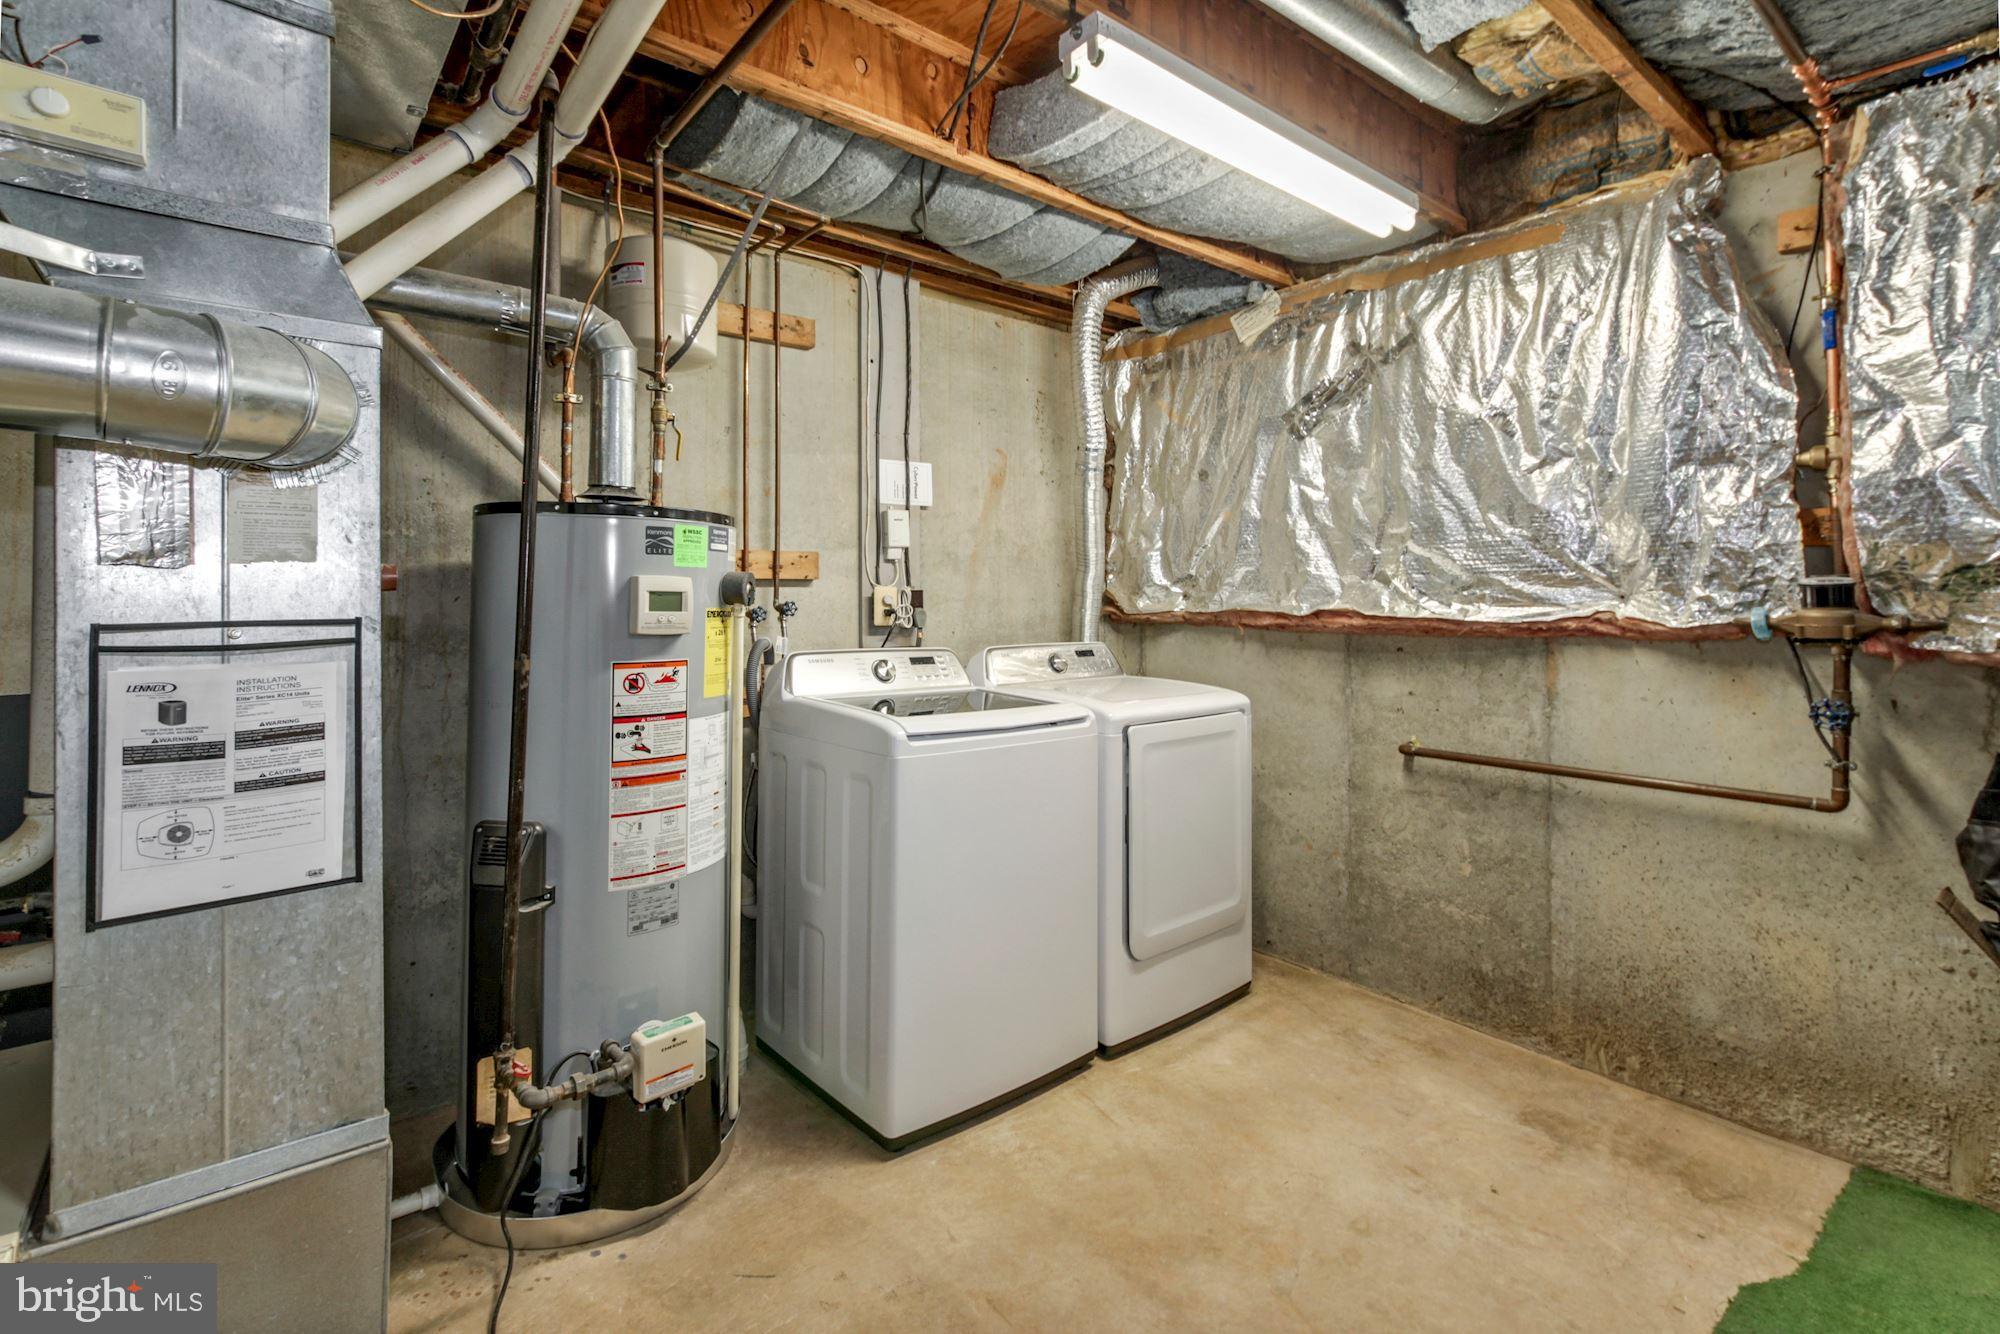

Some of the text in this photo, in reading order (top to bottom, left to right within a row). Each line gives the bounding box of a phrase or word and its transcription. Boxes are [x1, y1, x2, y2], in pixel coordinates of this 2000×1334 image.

[236, 675, 297, 686] INSTALLATION
[126, 684, 168, 693] LENNOX
[236, 682, 302, 693] INSTRUCTIONS
[266, 718, 300, 727] WARNING
[160, 735, 198, 744] WARNING
[269, 768, 302, 777] CAUTION
